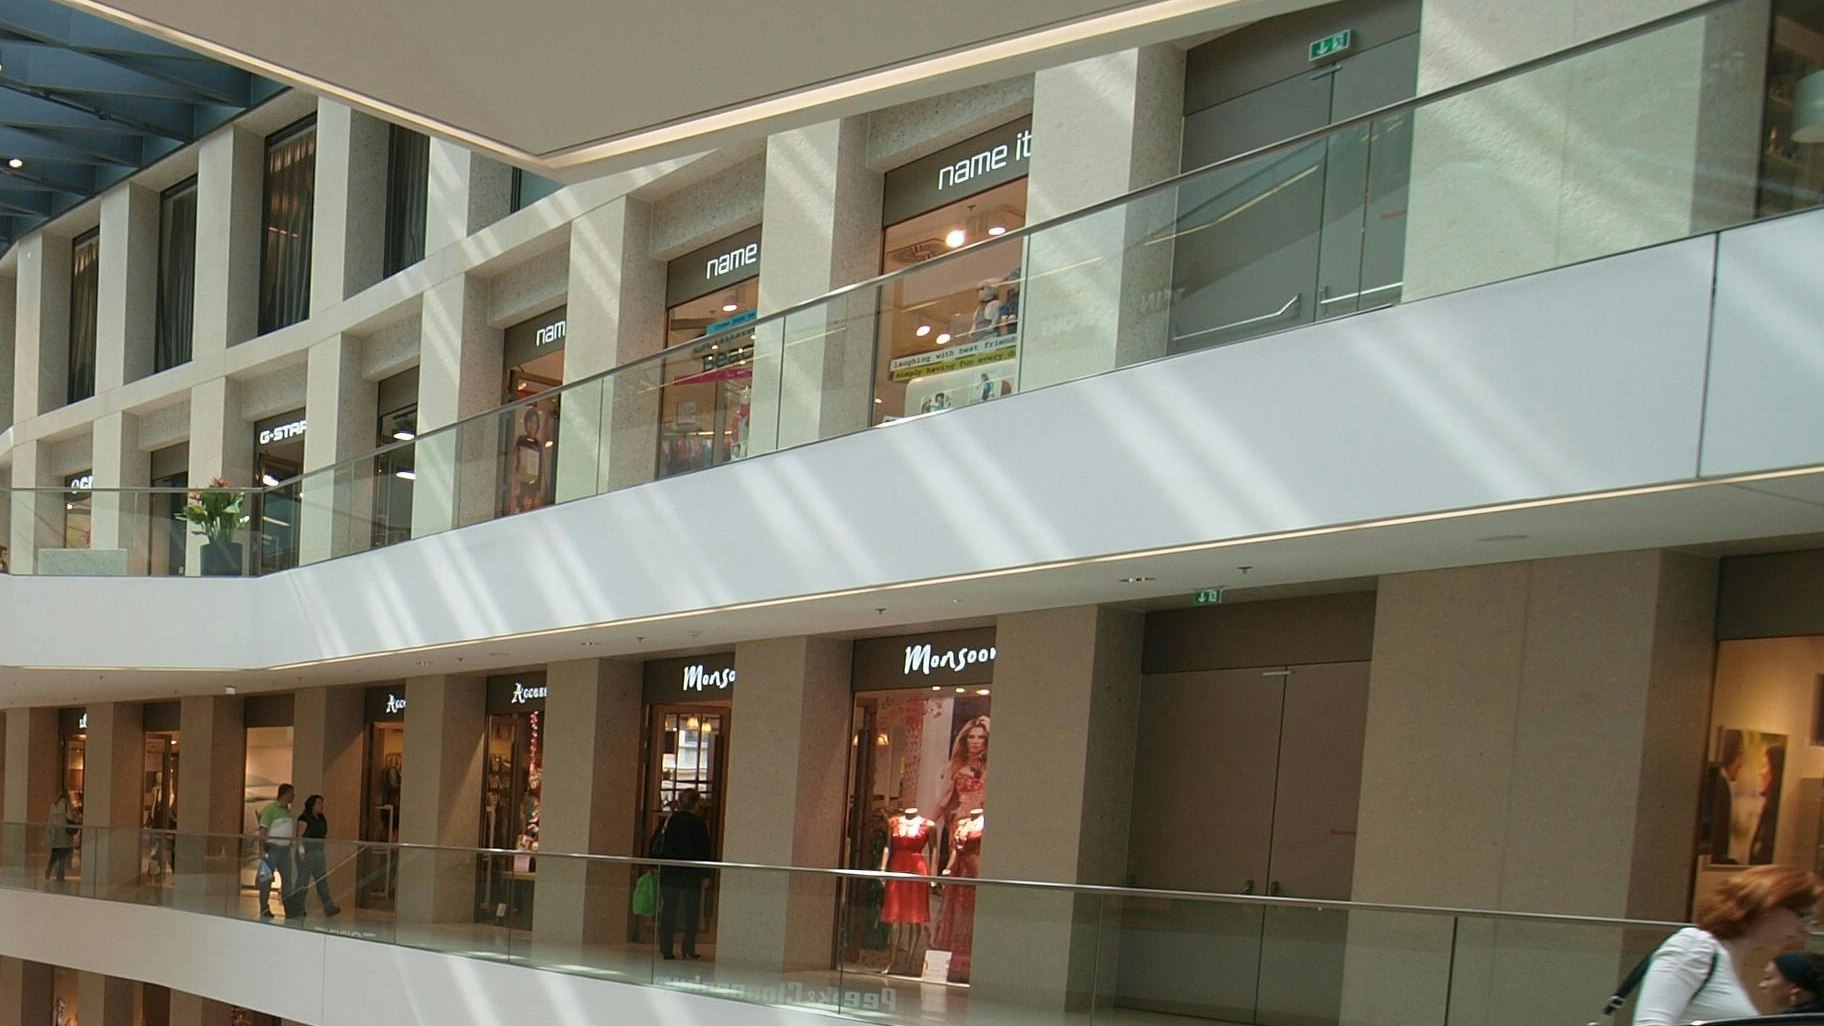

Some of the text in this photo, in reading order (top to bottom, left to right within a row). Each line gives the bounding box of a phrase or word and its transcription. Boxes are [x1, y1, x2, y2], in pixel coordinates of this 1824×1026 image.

[939, 130, 1033, 190] name it
[706, 243, 758, 280] name
[936, 350, 954, 359] with
[959, 345, 978, 355] best
